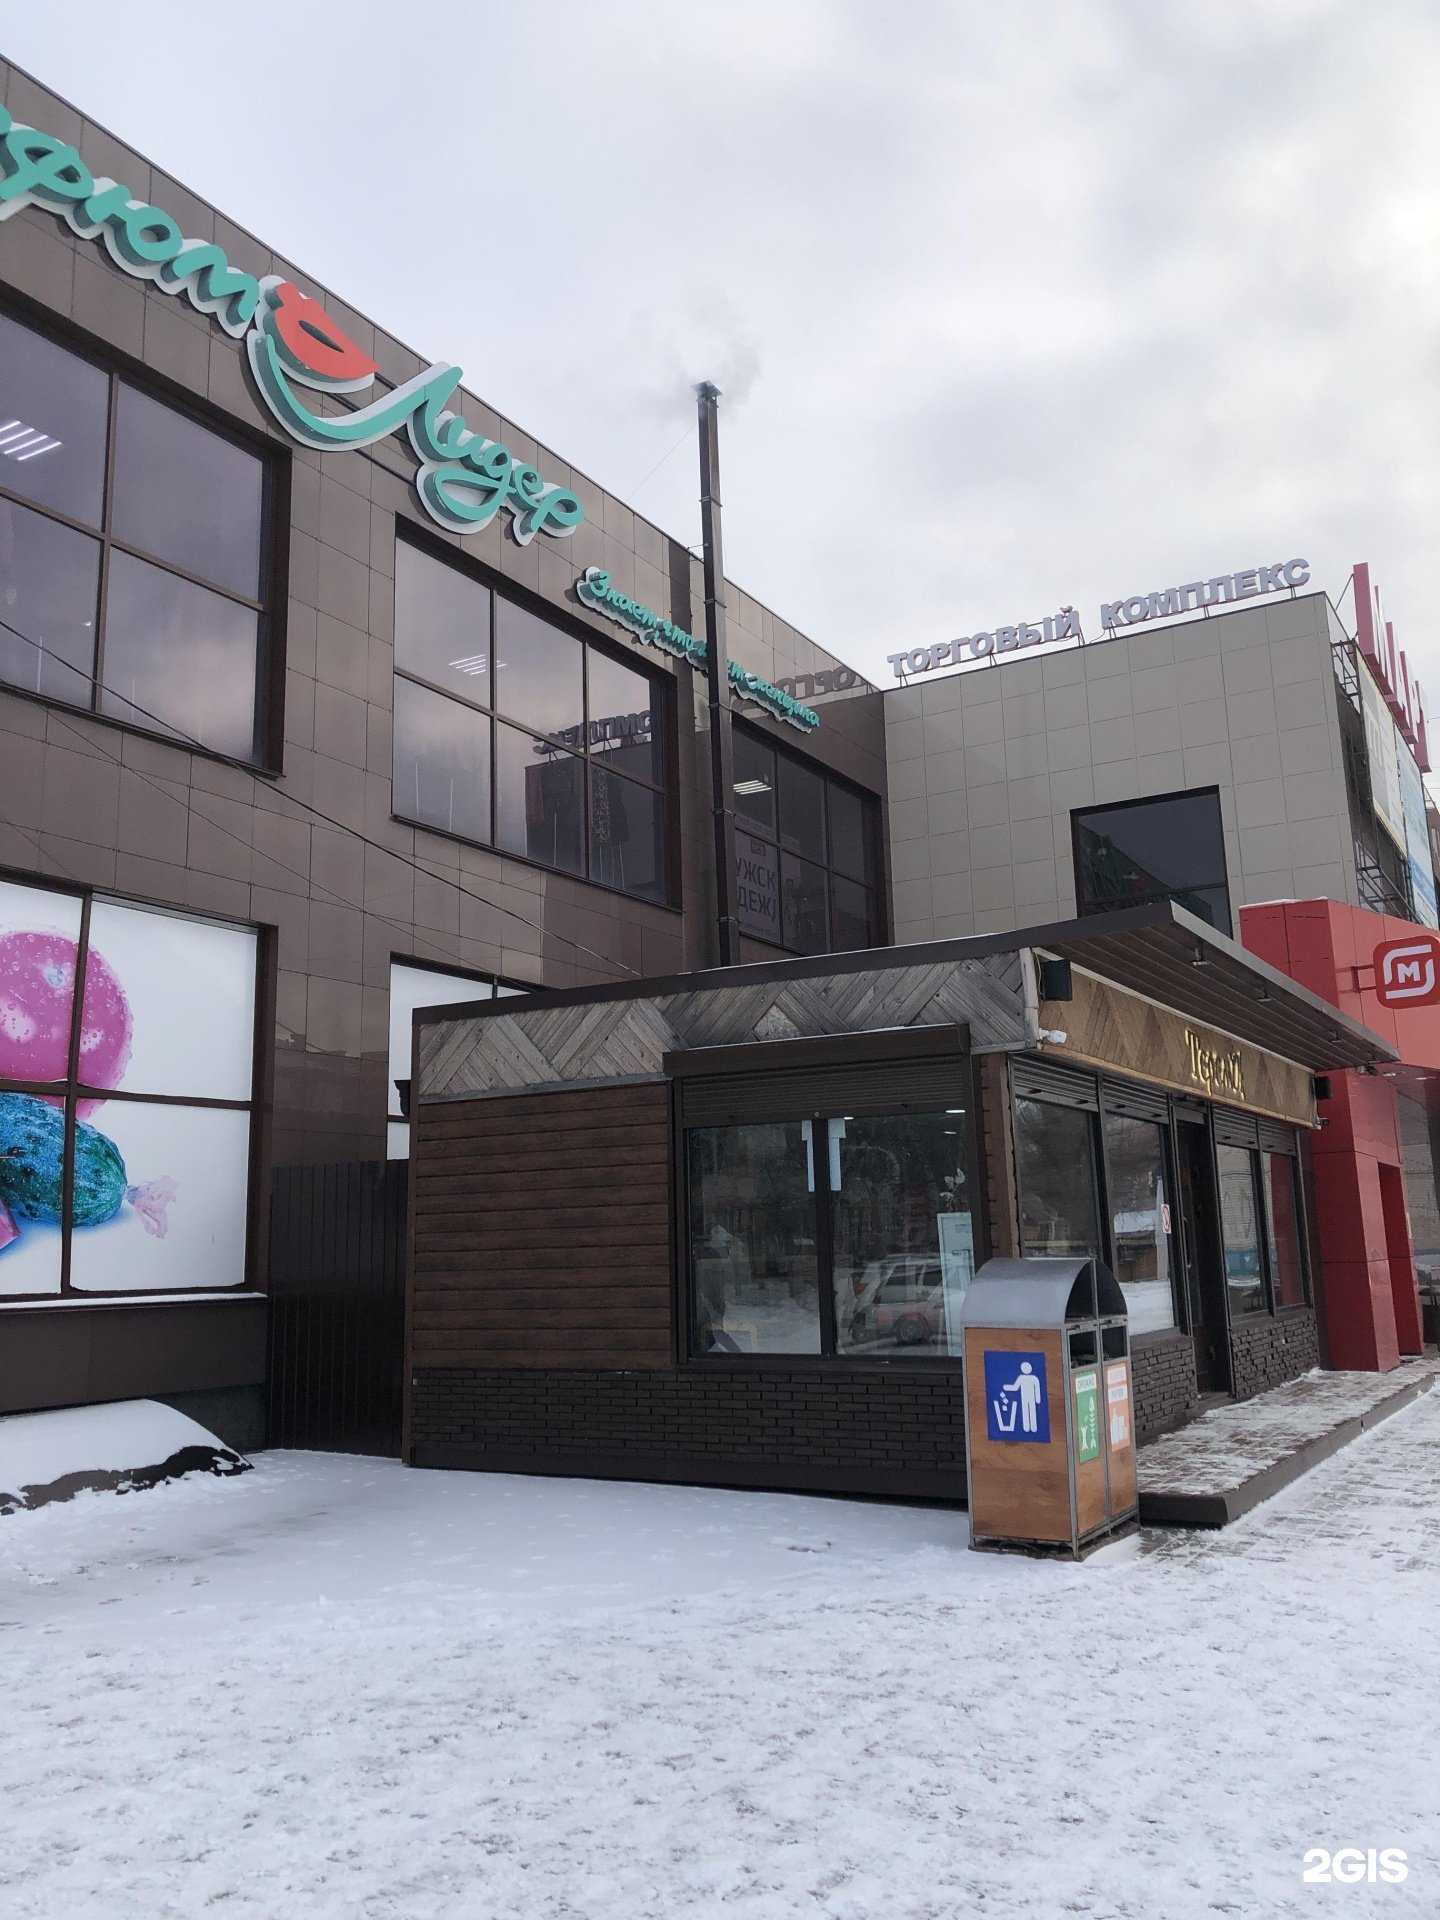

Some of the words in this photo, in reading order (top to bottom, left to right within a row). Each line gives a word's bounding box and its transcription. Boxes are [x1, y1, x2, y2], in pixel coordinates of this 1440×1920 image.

[0, 103, 261, 327] фюм
[264, 366, 584, 532] Лидер
[887, 605, 1081, 677] ТОРГОВЫЙ
[1101, 558, 1310, 629] КОМПЛЕКС
